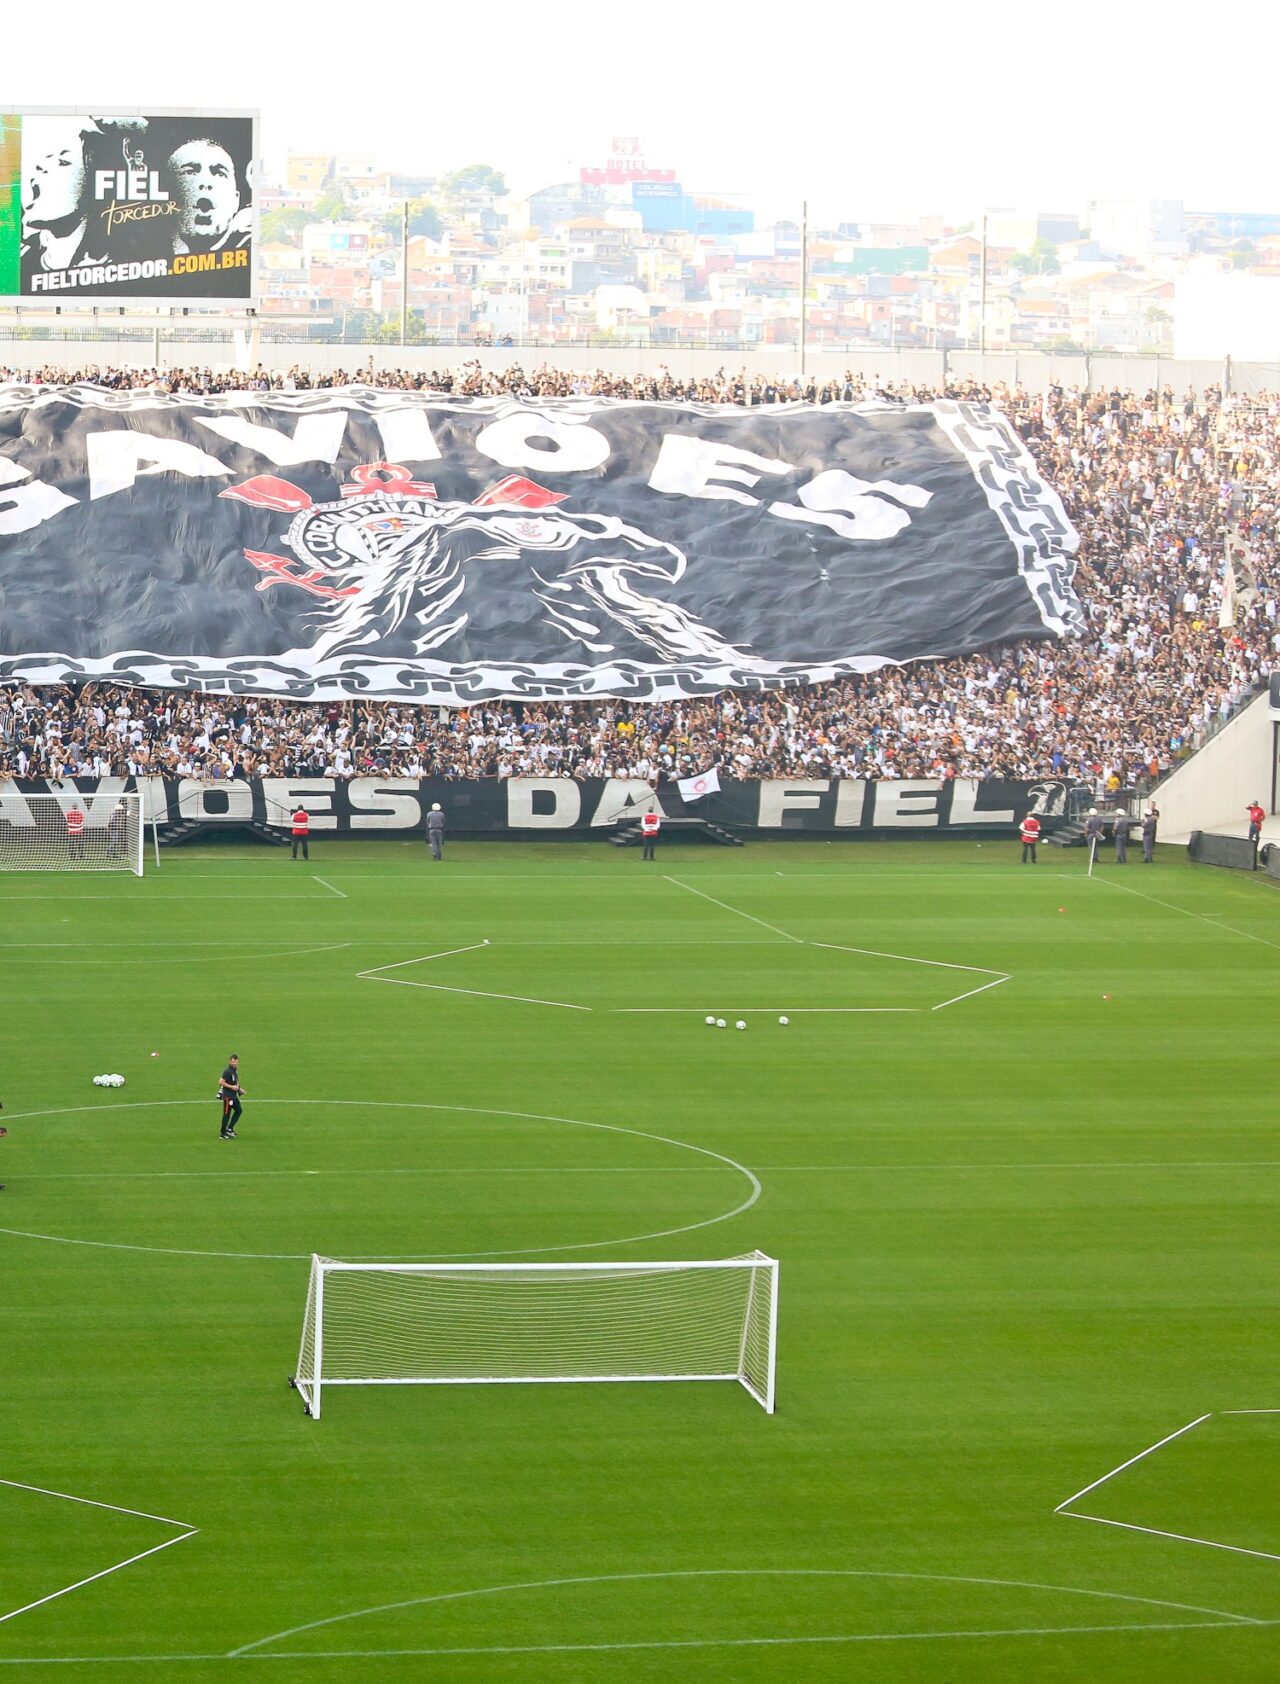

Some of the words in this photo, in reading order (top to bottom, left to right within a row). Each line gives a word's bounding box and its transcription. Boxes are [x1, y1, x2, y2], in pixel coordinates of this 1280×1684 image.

[95, 170, 170, 200] FIEL
[101, 199, 181, 236] TORCEDOR
[31, 250, 248, 292] FIELTORCEDOR.COM.BR
[507, 777, 670, 829] DA
[757, 778, 1015, 828] FIEL
